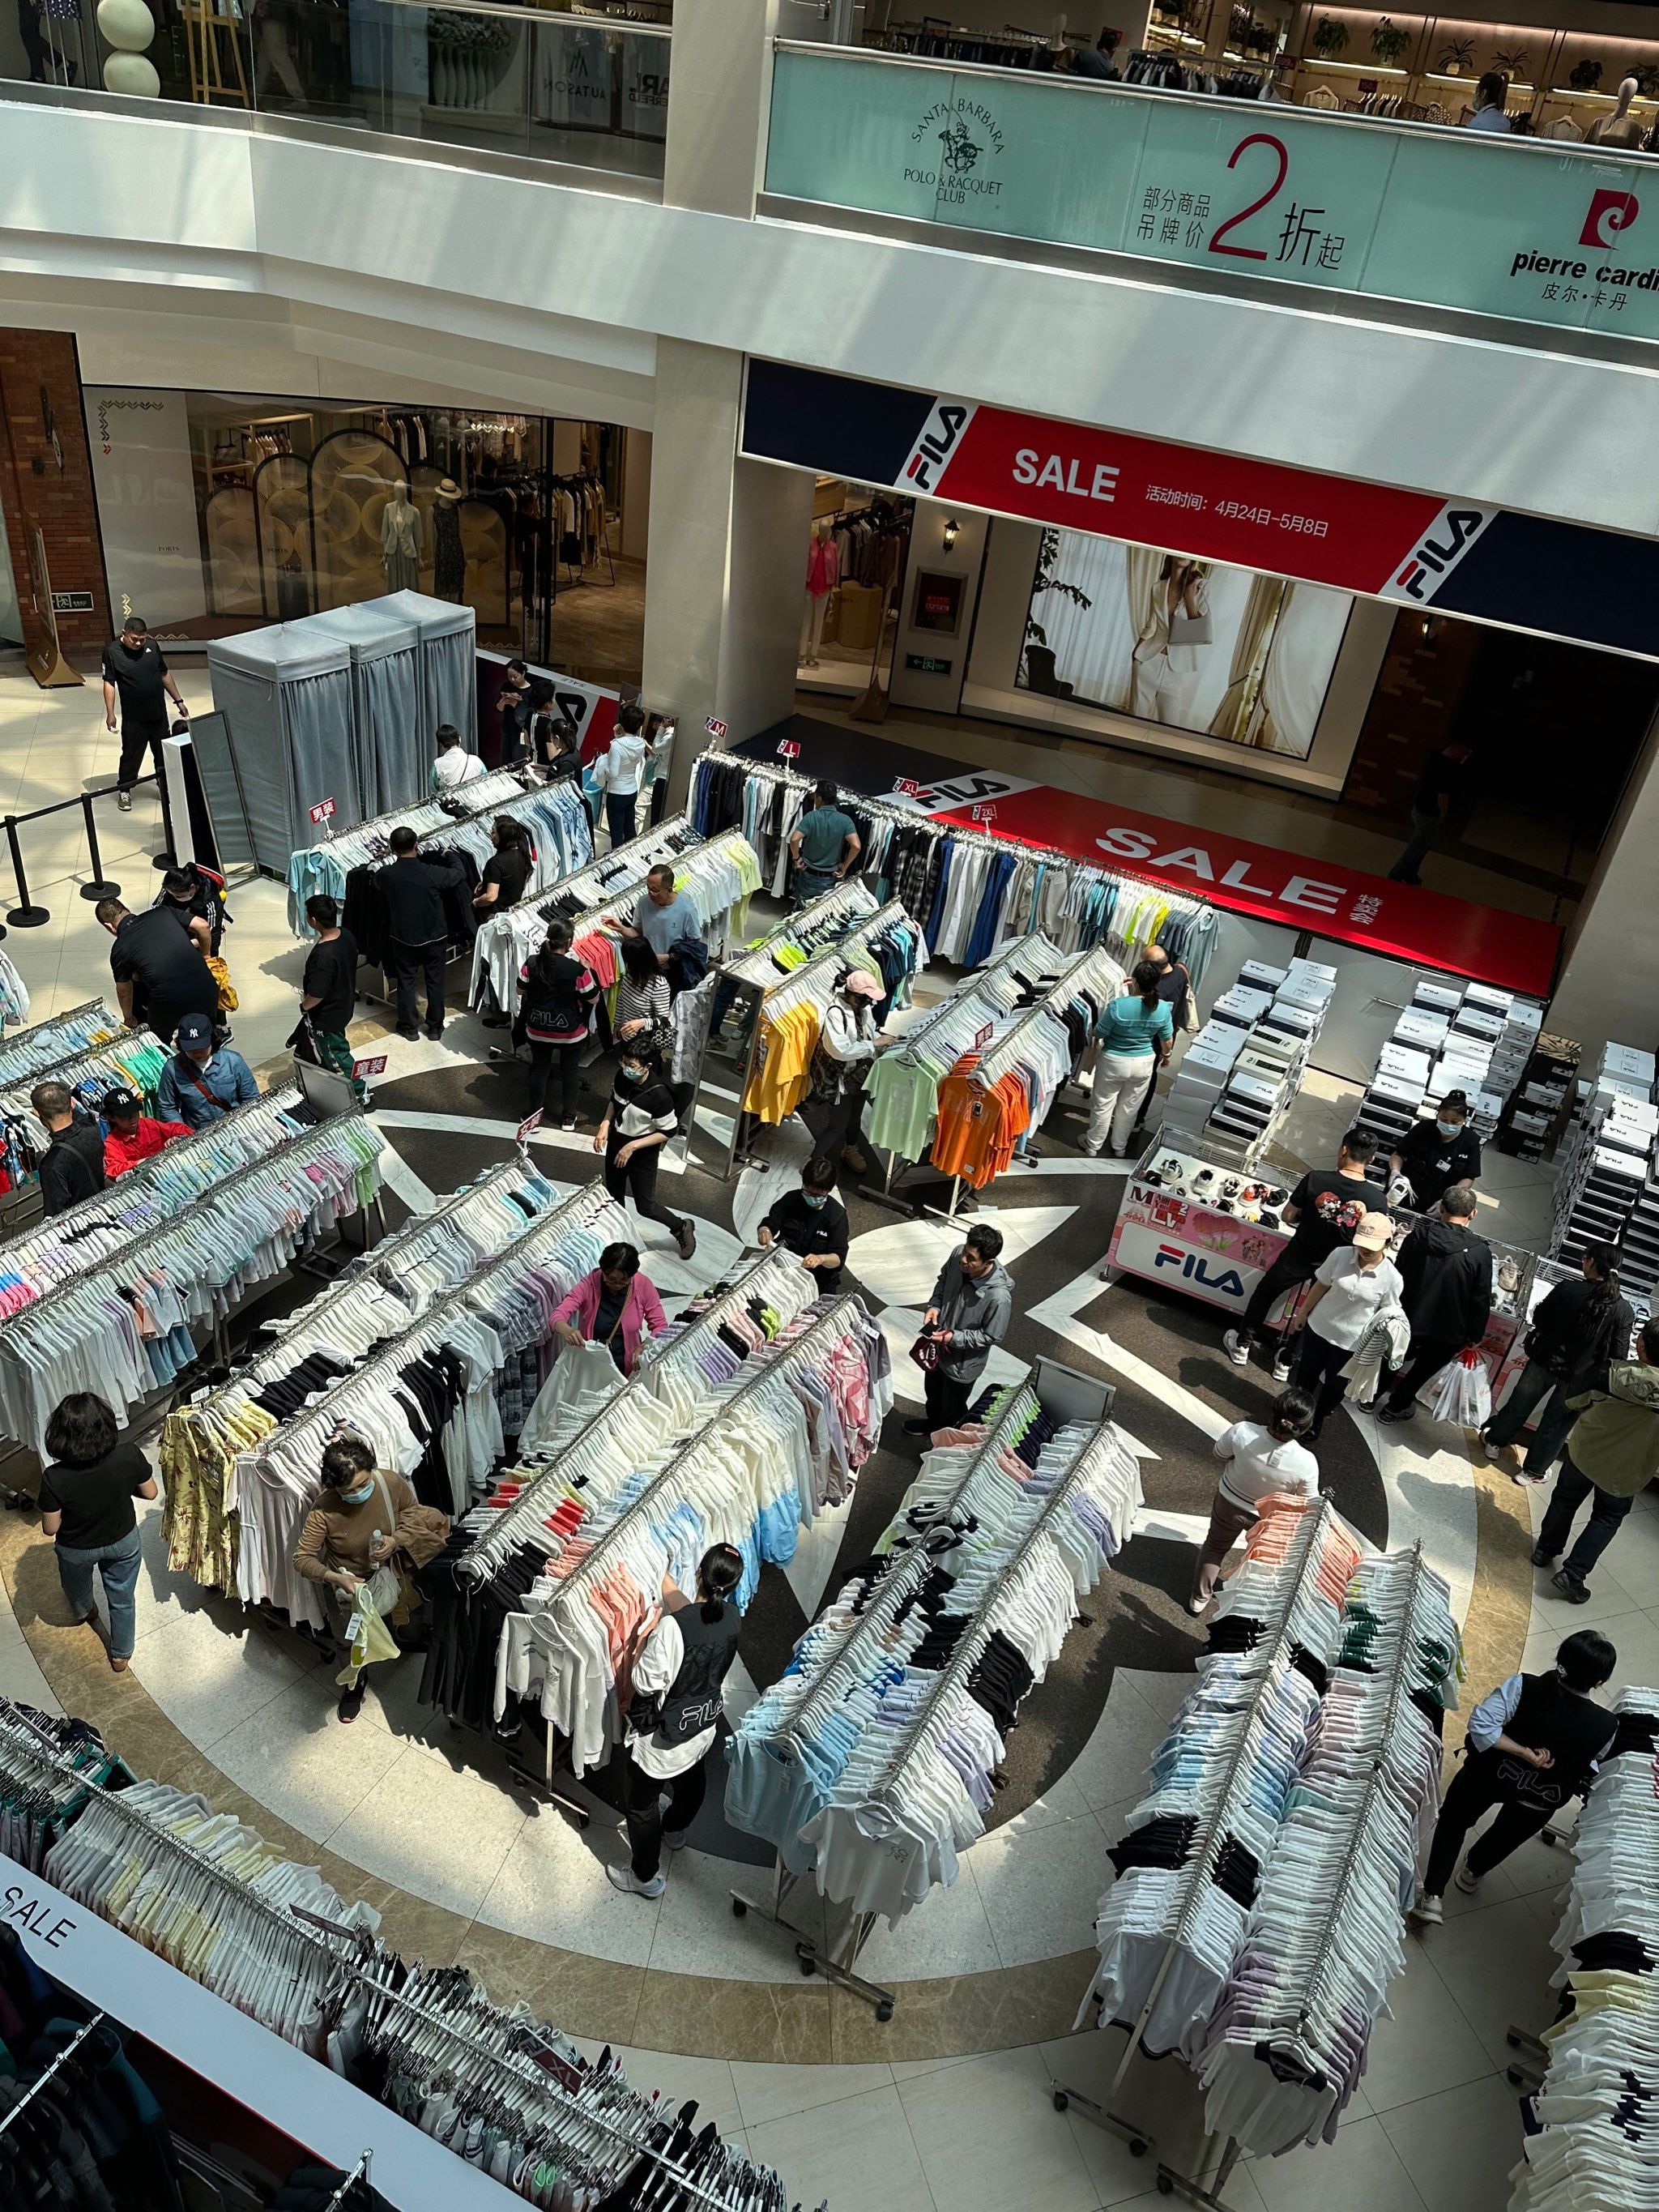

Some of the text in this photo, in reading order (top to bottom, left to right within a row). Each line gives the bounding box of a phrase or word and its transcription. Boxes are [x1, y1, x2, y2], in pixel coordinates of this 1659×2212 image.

[911, 98, 1004, 155] SANTA BARBARA
[904, 169, 1003, 195] POLO & RACQUET
[936, 187, 966, 203] CLUB
[1142, 186, 1211, 219] 部分商品
[1137, 213, 1205, 249] 吊牌价
[1510, 250, 1659, 291] pierre cardi
[906, 406, 967, 490] FILA
[1013, 449, 1120, 502] SALE
[1396, 510, 1483, 600] FILA
[715, 723, 725, 736] M
[789, 743, 796, 755] L
[893, 779, 916, 794] FILA XL
[909, 778, 1011, 809] FILA
[313, 801, 335, 822] 男装
[981, 808, 995, 817] 2XL
[1095, 826, 1347, 915] SALE
[530, 1009, 569, 1028] FILA
[1479, 1017, 1496, 1025] FILA
[356, 1057, 385, 1077] 童装
[1256, 1086, 1273, 1094] FILA
[1380, 1081, 1399, 1091] FILA
[1609, 1127, 1627, 1135] FILA
[1154, 1244, 1244, 1297] FILA
[1497, 1758, 1562, 1803] FILA
[5, 1886, 78, 1949] SALE
[548, 2057, 576, 2090] XL
